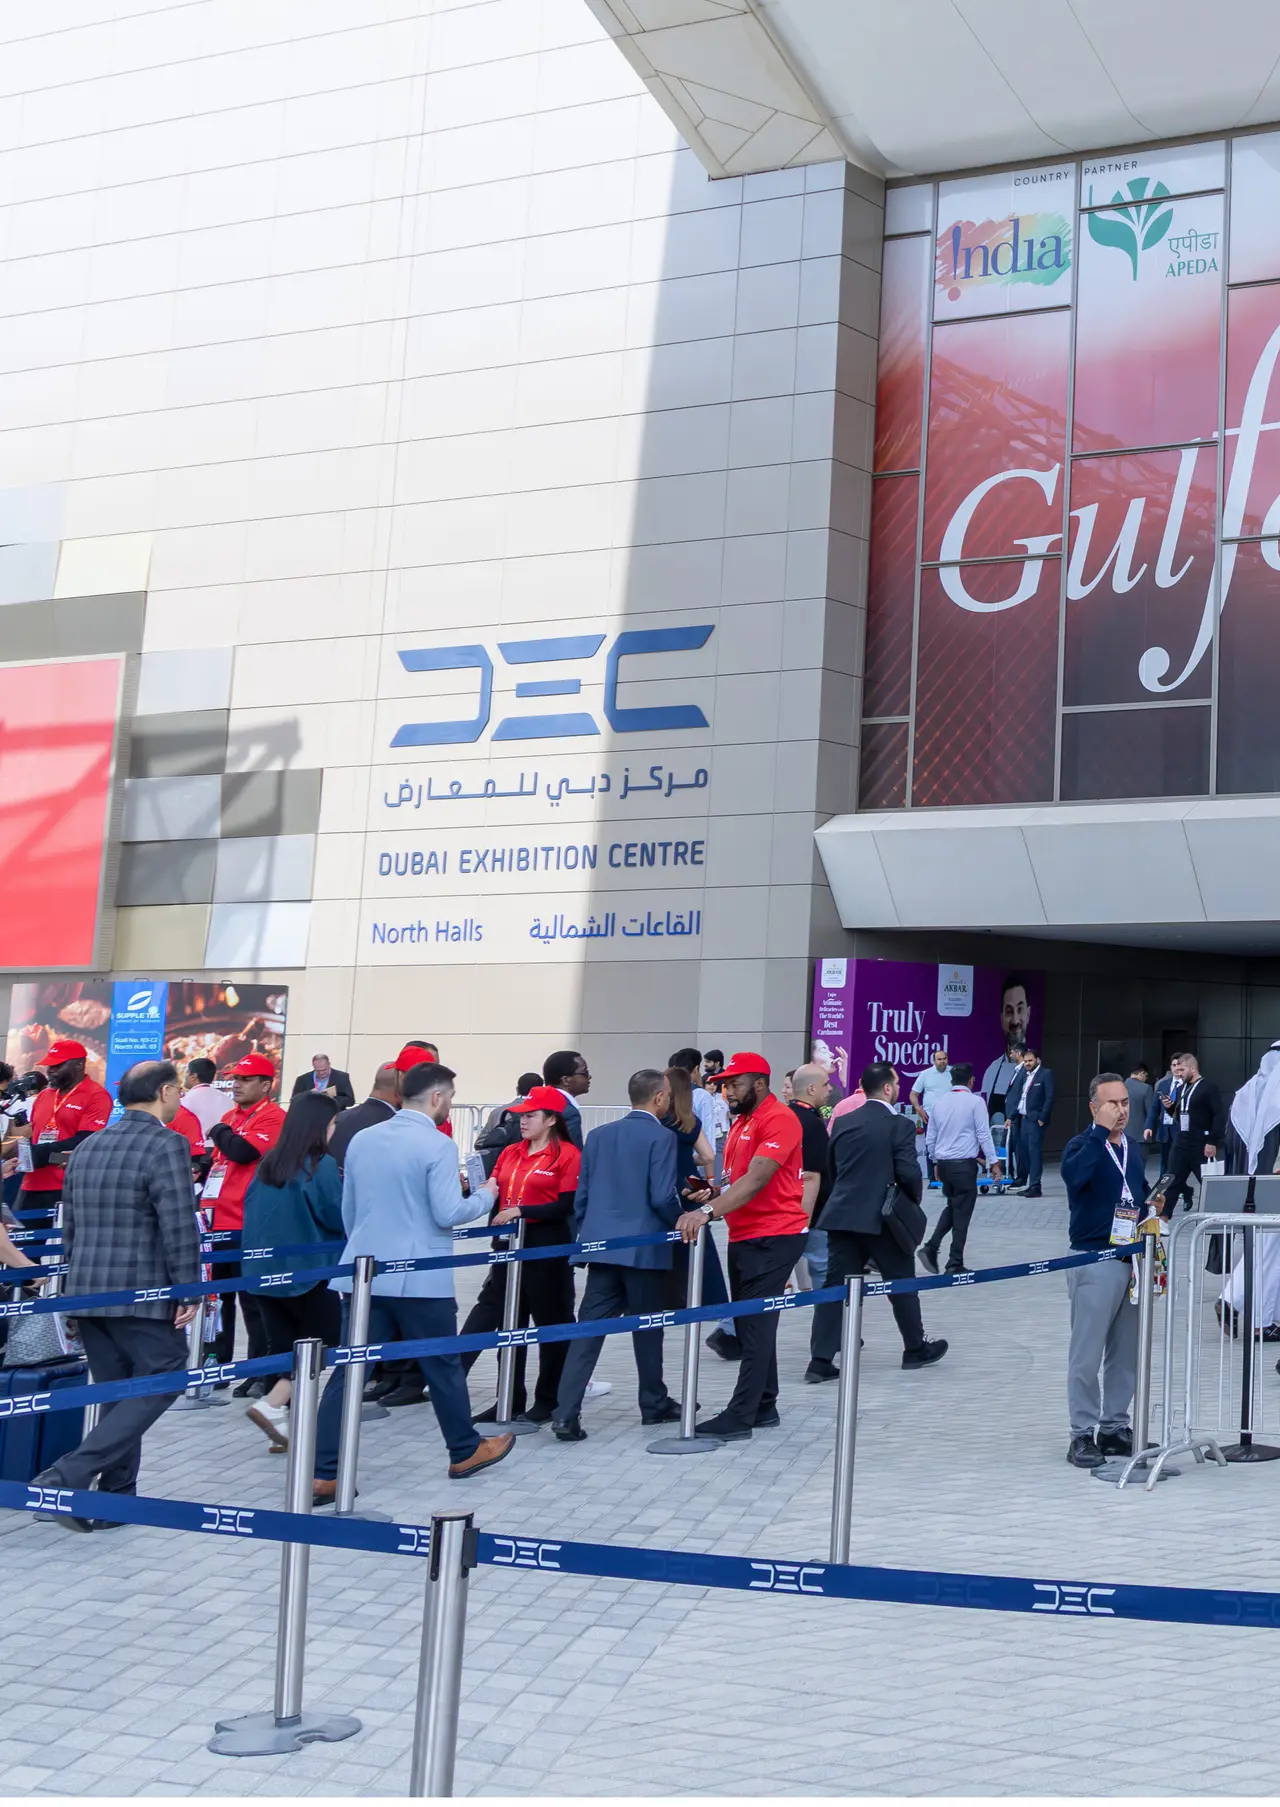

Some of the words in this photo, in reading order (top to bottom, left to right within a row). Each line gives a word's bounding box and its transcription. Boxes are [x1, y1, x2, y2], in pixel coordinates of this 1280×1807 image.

[1013, 170, 1070, 187] COUNTRY
[1084, 160, 1139, 176] PARTNER
[1167, 228, 1220, 258] एपीडा
[1165, 258, 1219, 278] APEDA
[384, 772, 538, 809] للمعارض
[546, 773, 611, 808] دبي
[619, 763, 709, 799] مركز
[378, 850, 448, 877] DUBAI
[458, 845, 598, 874] EXHIBITION
[608, 840, 705, 869] CENTRE
[372, 921, 429, 946] North
[435, 918, 484, 943] Halls
[528, 913, 616, 946] الشمالية
[621, 910, 701, 940] القاعات
[943, 984, 968, 993] AKBAR
[867, 1002, 926, 1041] Truly
[873, 1034, 949, 1066] Special
[260, 1272, 293, 1287] DEC
[134, 1287, 171, 1302] DEC
[763, 1294, 797, 1311] DEC
[639, 1311, 675, 1329] DEC
[497, 1328, 538, 1346] DEC
[335, 1345, 382, 1364] DEC
[187, 1363, 235, 1387] DEC
[25, 1486, 74, 1512] DEC
[200, 1507, 255, 1535] DEC
[492, 1538, 561, 1569] DEC
[749, 1562, 825, 1593] DEC
[1032, 1583, 1115, 1615] DEC
